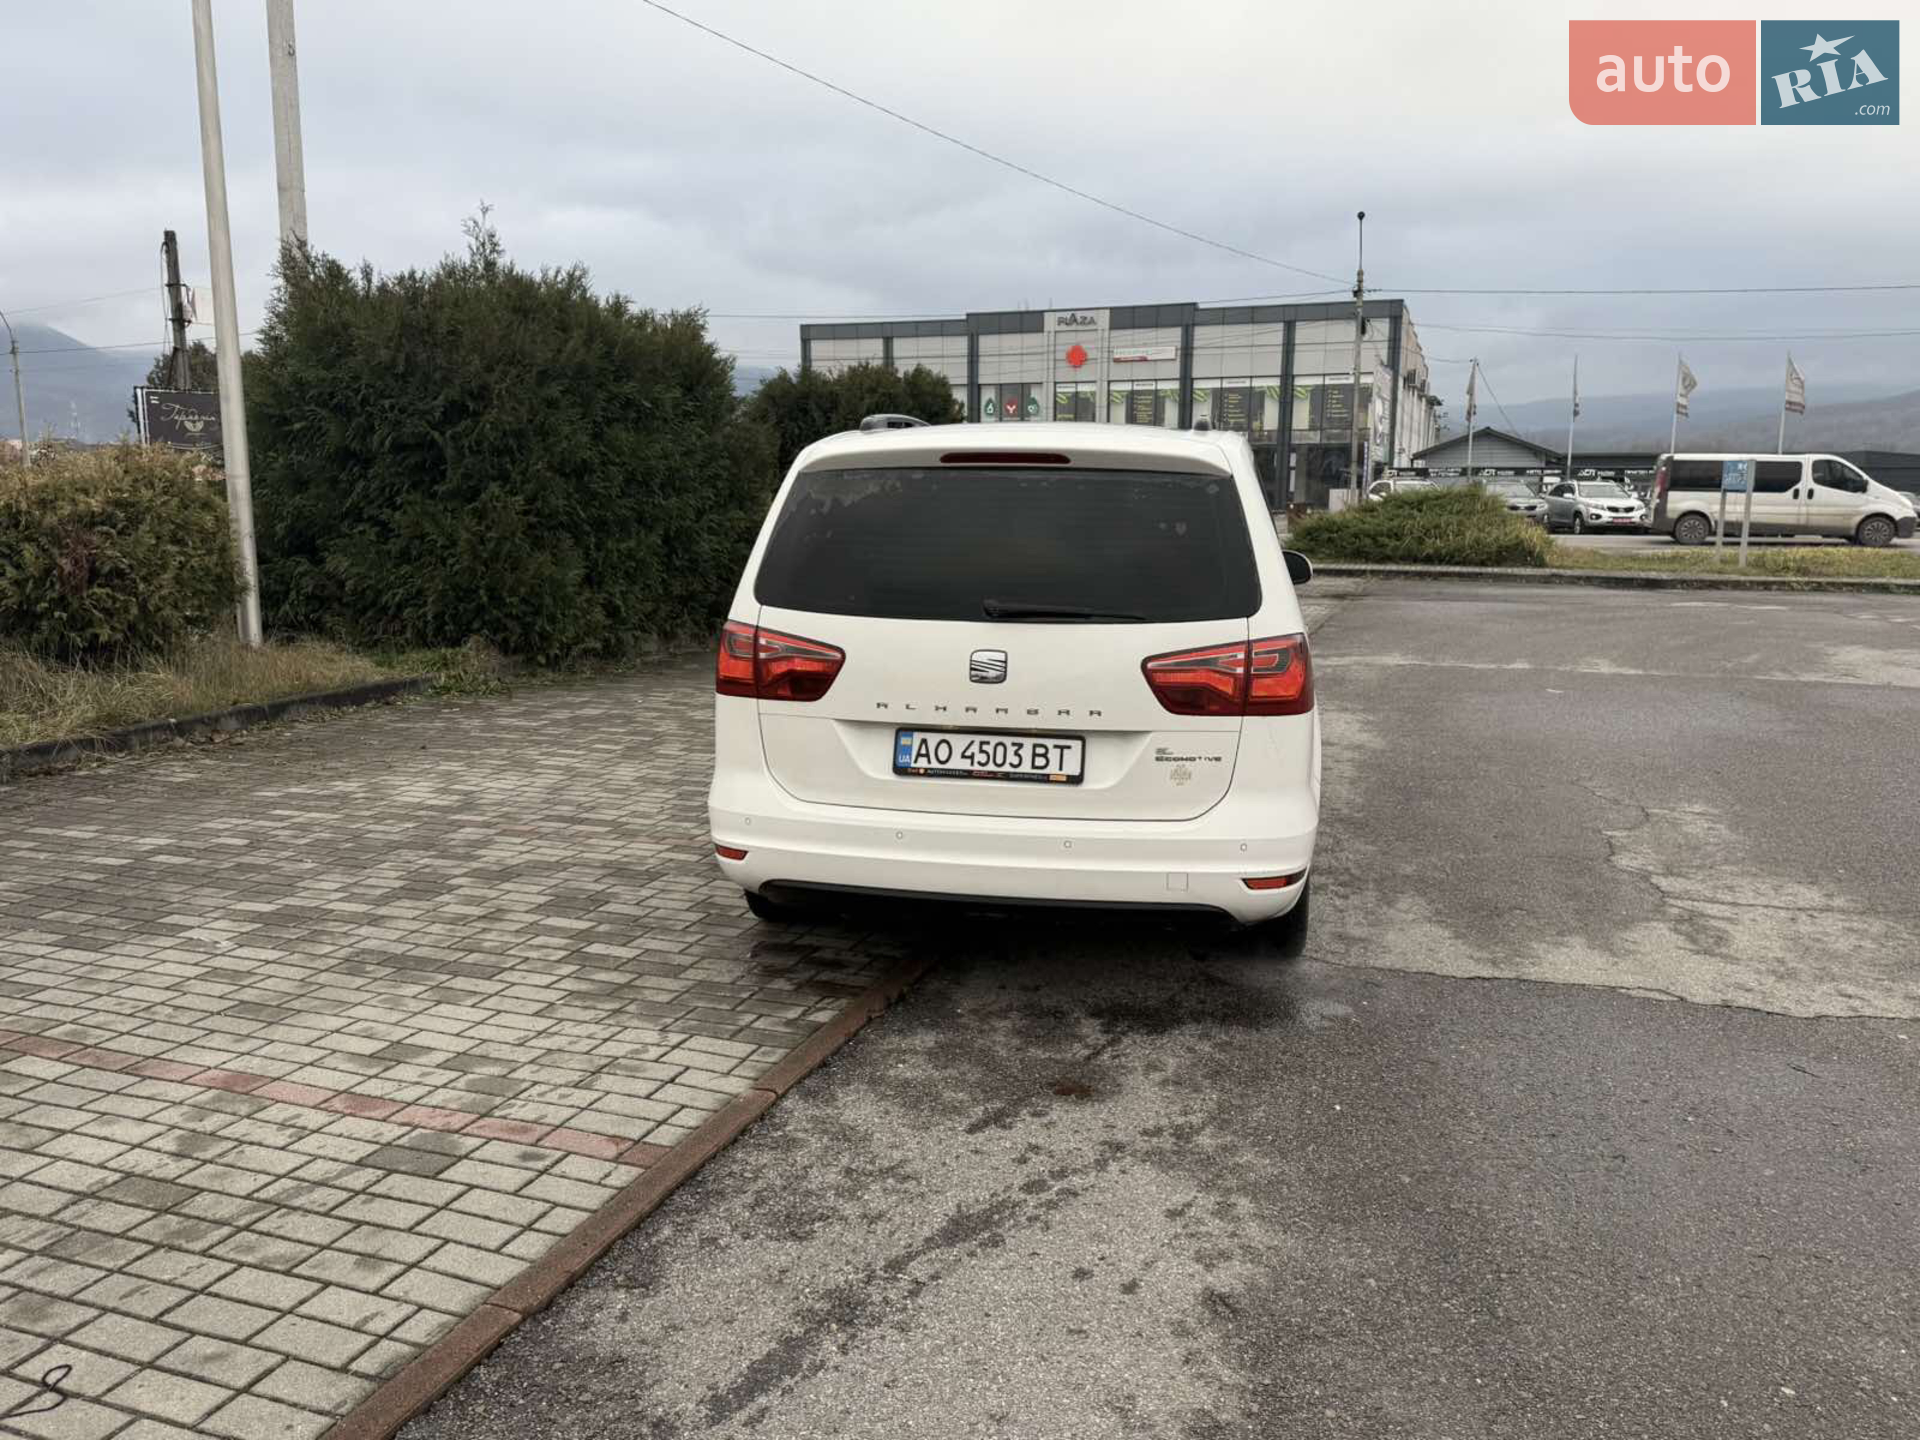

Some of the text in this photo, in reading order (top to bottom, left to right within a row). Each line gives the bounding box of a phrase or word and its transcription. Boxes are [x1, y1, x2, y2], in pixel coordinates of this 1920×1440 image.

[1056, 312, 1097, 327] PLAZA
[876, 702, 1103, 717] ALHAMBRA
[898, 755, 911, 763] UA
[913, 737, 1072, 772] AO 4503 BT
